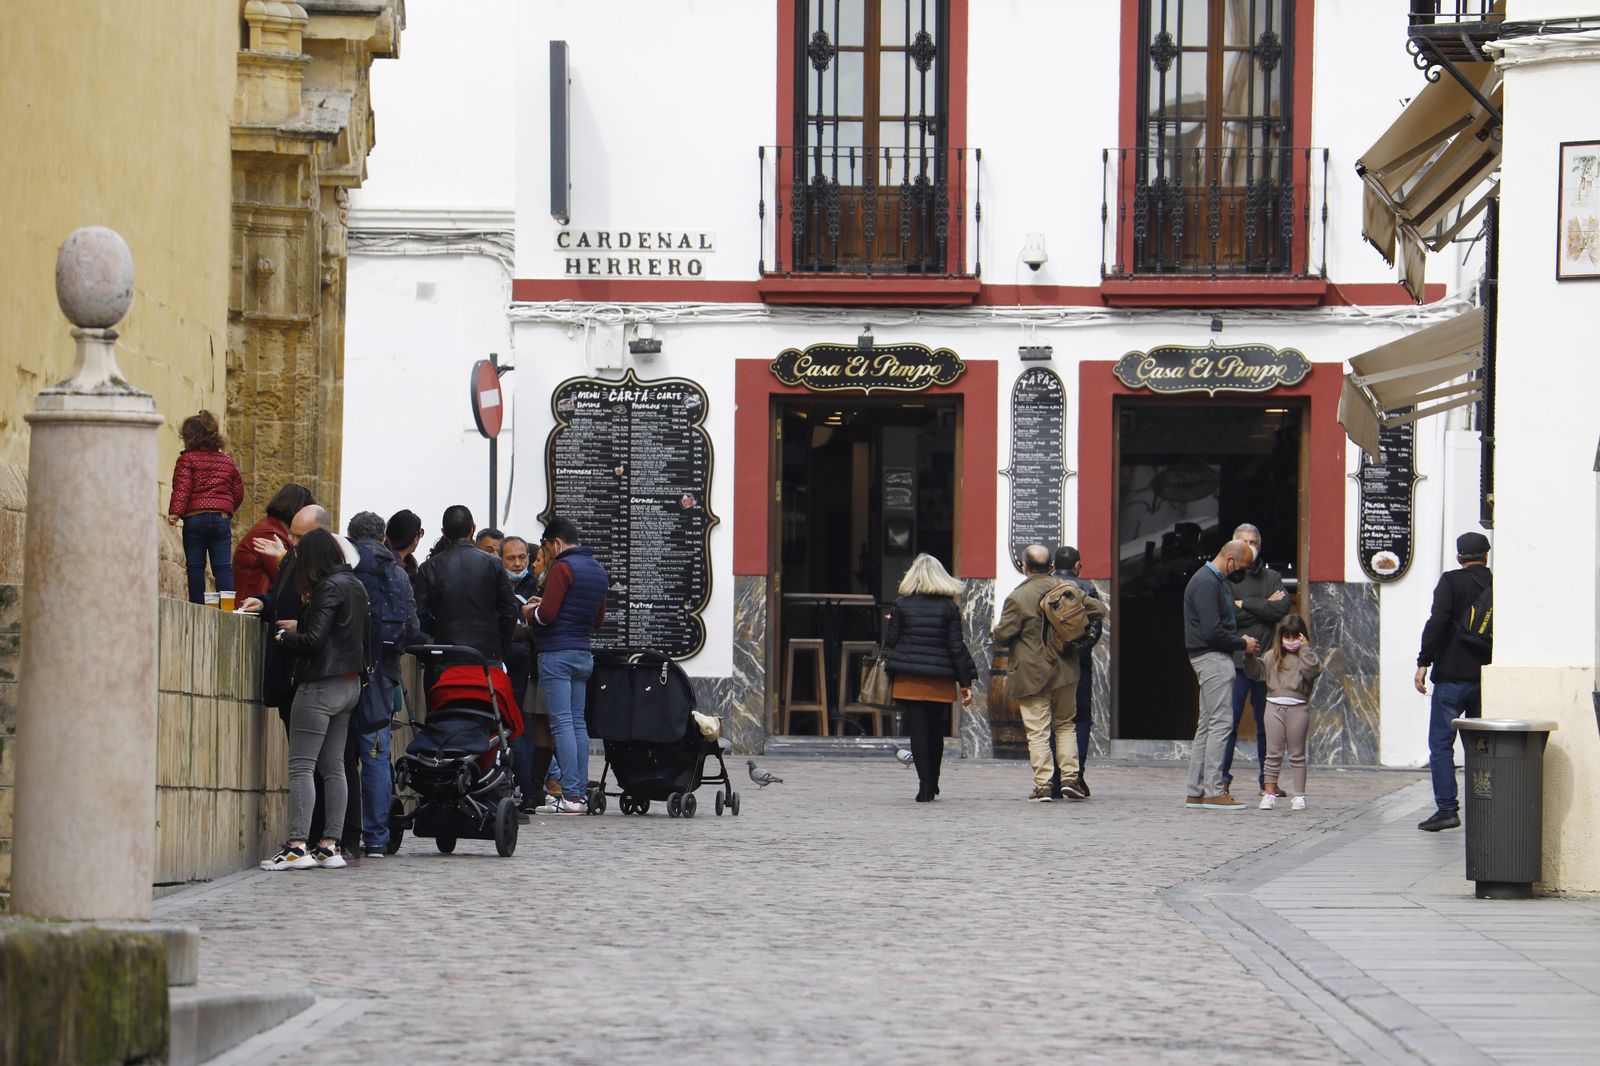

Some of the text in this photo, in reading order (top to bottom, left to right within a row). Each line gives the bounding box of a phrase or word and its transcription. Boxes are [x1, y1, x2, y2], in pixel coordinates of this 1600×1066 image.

[557, 231, 712, 249] CARDENAL
[565, 258, 703, 276] HERRERO
[793, 354, 942, 383] Casa El Pimpo
[1136, 355, 1288, 384] Casa El Pimpo
[1020, 373, 1058, 390] TAPAS
[577, 389, 682, 402] MENU CARTA CARTE
